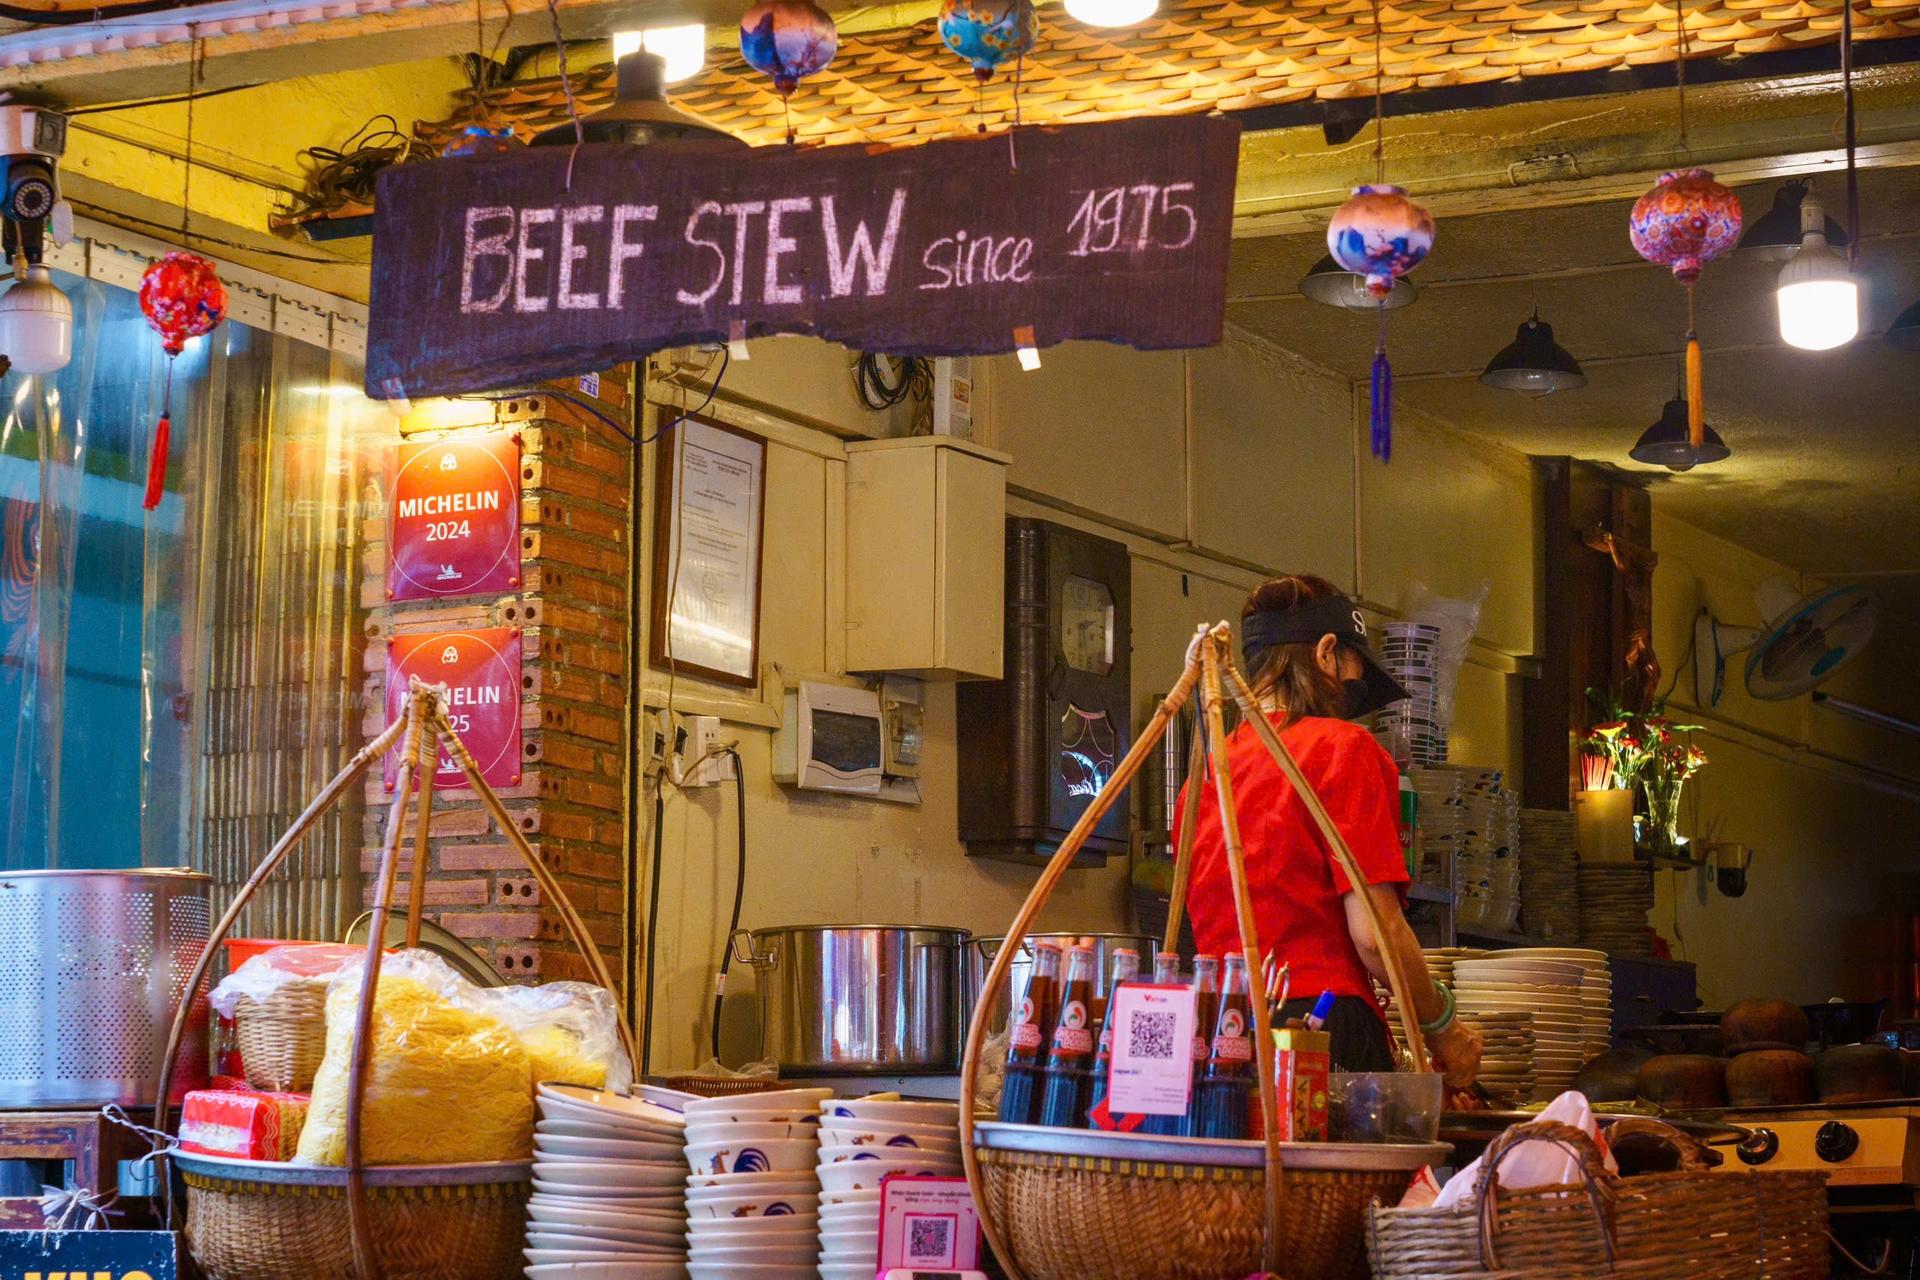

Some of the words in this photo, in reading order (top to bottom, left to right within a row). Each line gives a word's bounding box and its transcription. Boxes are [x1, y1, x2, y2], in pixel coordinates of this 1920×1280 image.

[460, 204, 659, 313] BEEF
[676, 188, 907, 306] STEW
[919, 230, 1033, 290] since
[1067, 182, 1198, 257] 1975
[399, 490, 499, 518] MICHELIN
[426, 520, 471, 541] 2024
[401, 686, 500, 707] ELIN
[448, 715, 470, 733] 25
